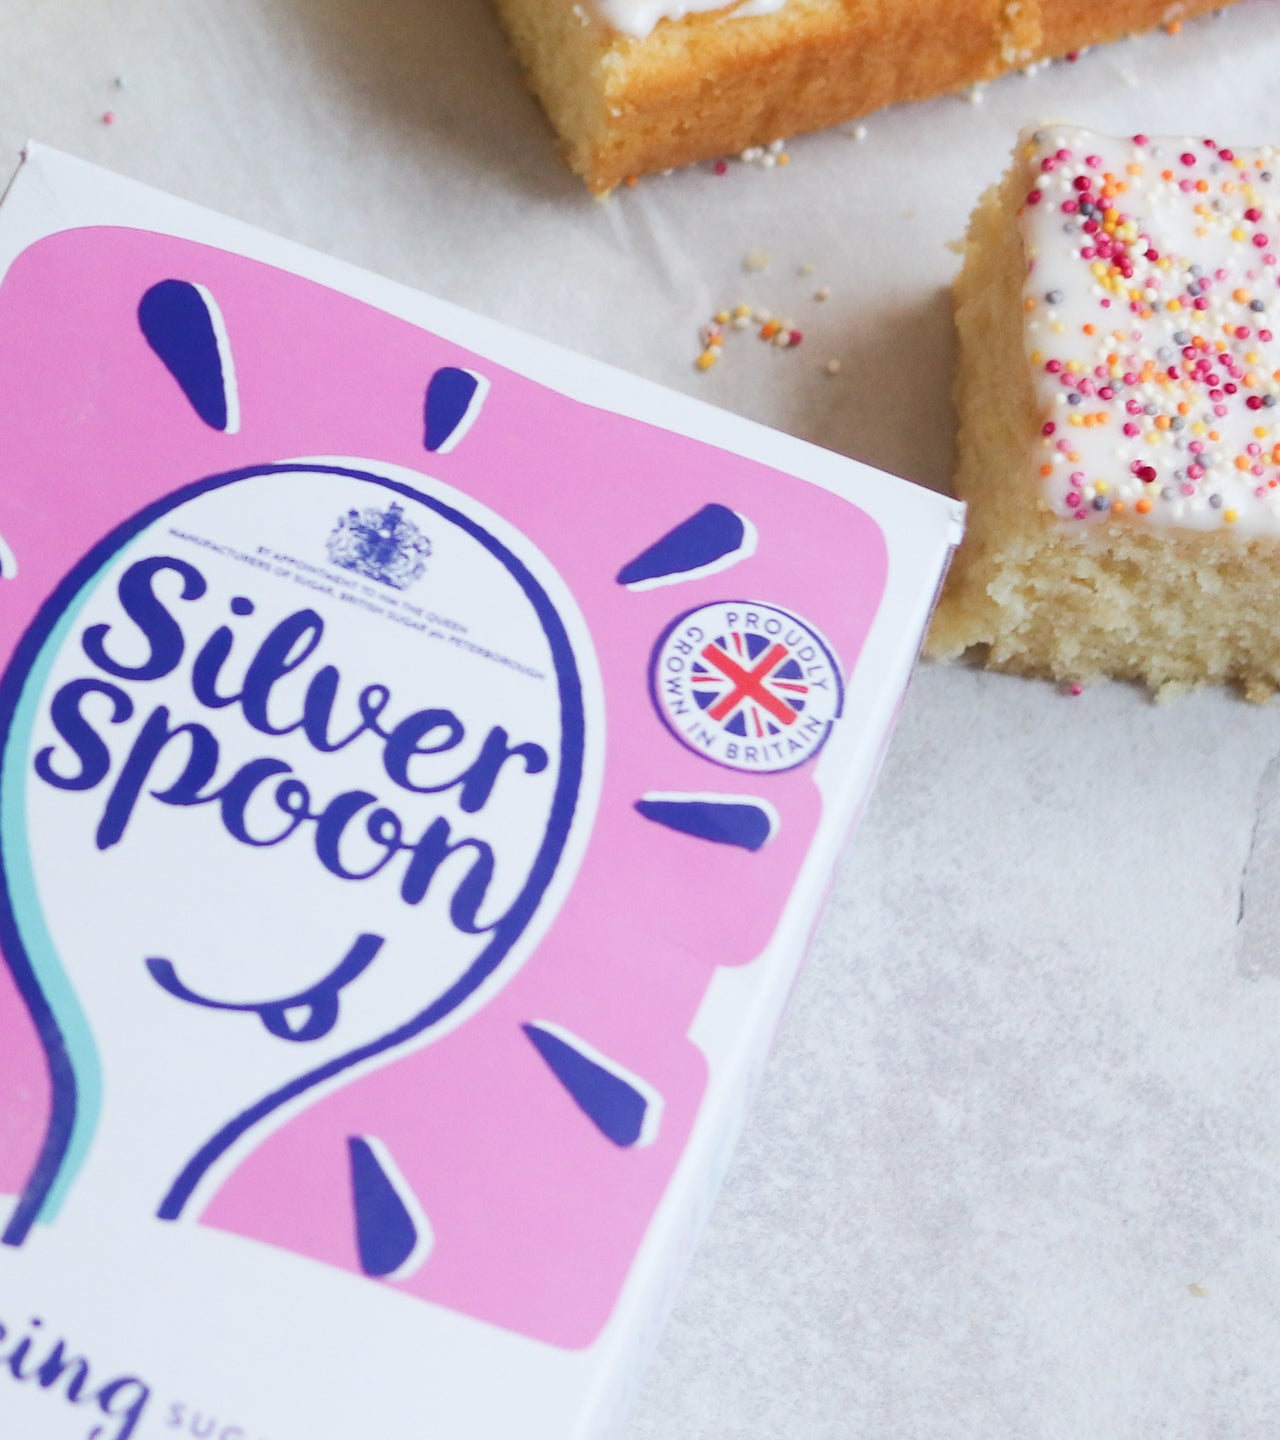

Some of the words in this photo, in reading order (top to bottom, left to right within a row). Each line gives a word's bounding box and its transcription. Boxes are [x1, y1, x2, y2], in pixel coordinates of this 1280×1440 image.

[81, 555, 549, 814] Silver
[666, 626, 705, 716] GROWN
[687, 721, 716, 747] IN
[725, 715, 824, 763] BRITAIN
[726, 612, 829, 691] PROUDLY
